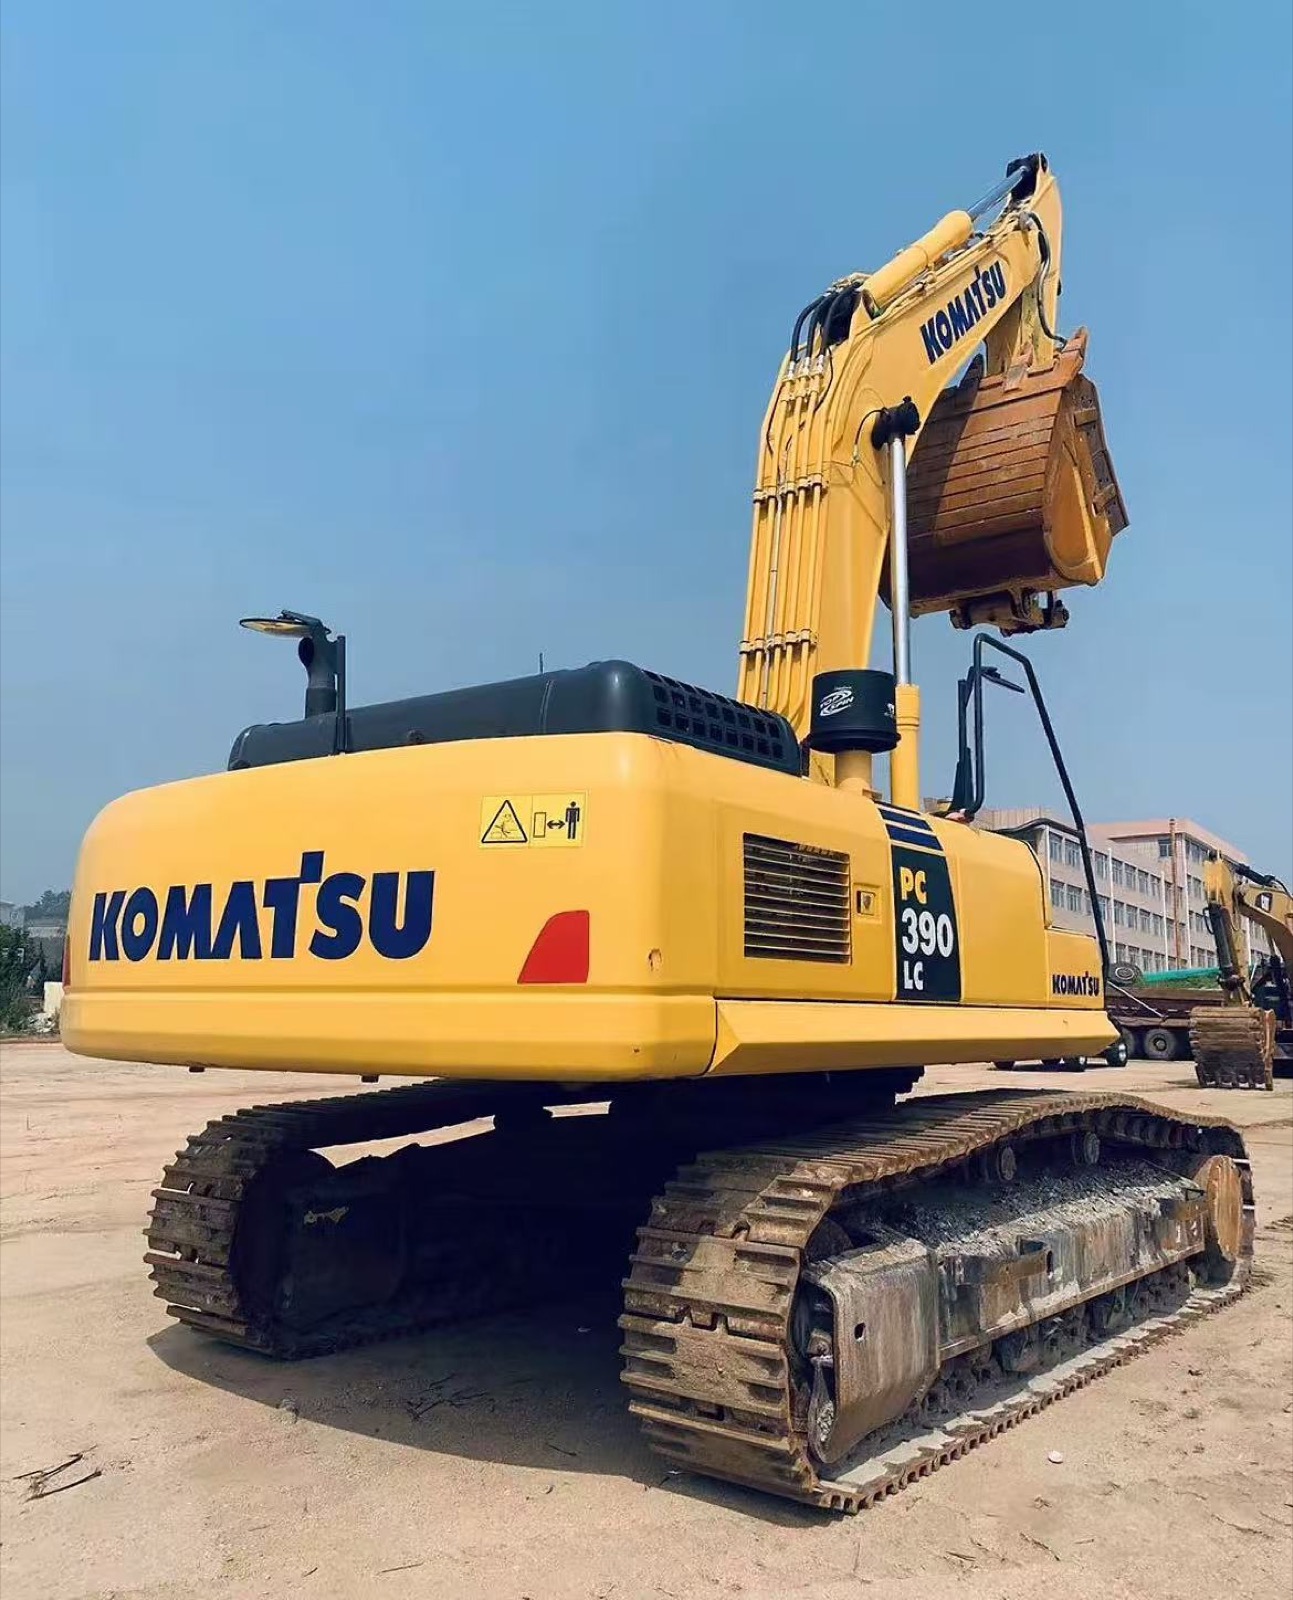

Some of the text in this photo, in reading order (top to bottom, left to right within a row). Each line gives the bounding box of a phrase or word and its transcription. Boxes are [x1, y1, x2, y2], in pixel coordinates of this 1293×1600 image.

[920, 261, 1006, 364] KOMATSU
[90, 851, 434, 961] KOMATSU
[900, 867, 927, 904] PC
[902, 907, 954, 958] 390
[904, 961, 925, 991] LC
[1052, 972, 1099, 996] KOMATSU
